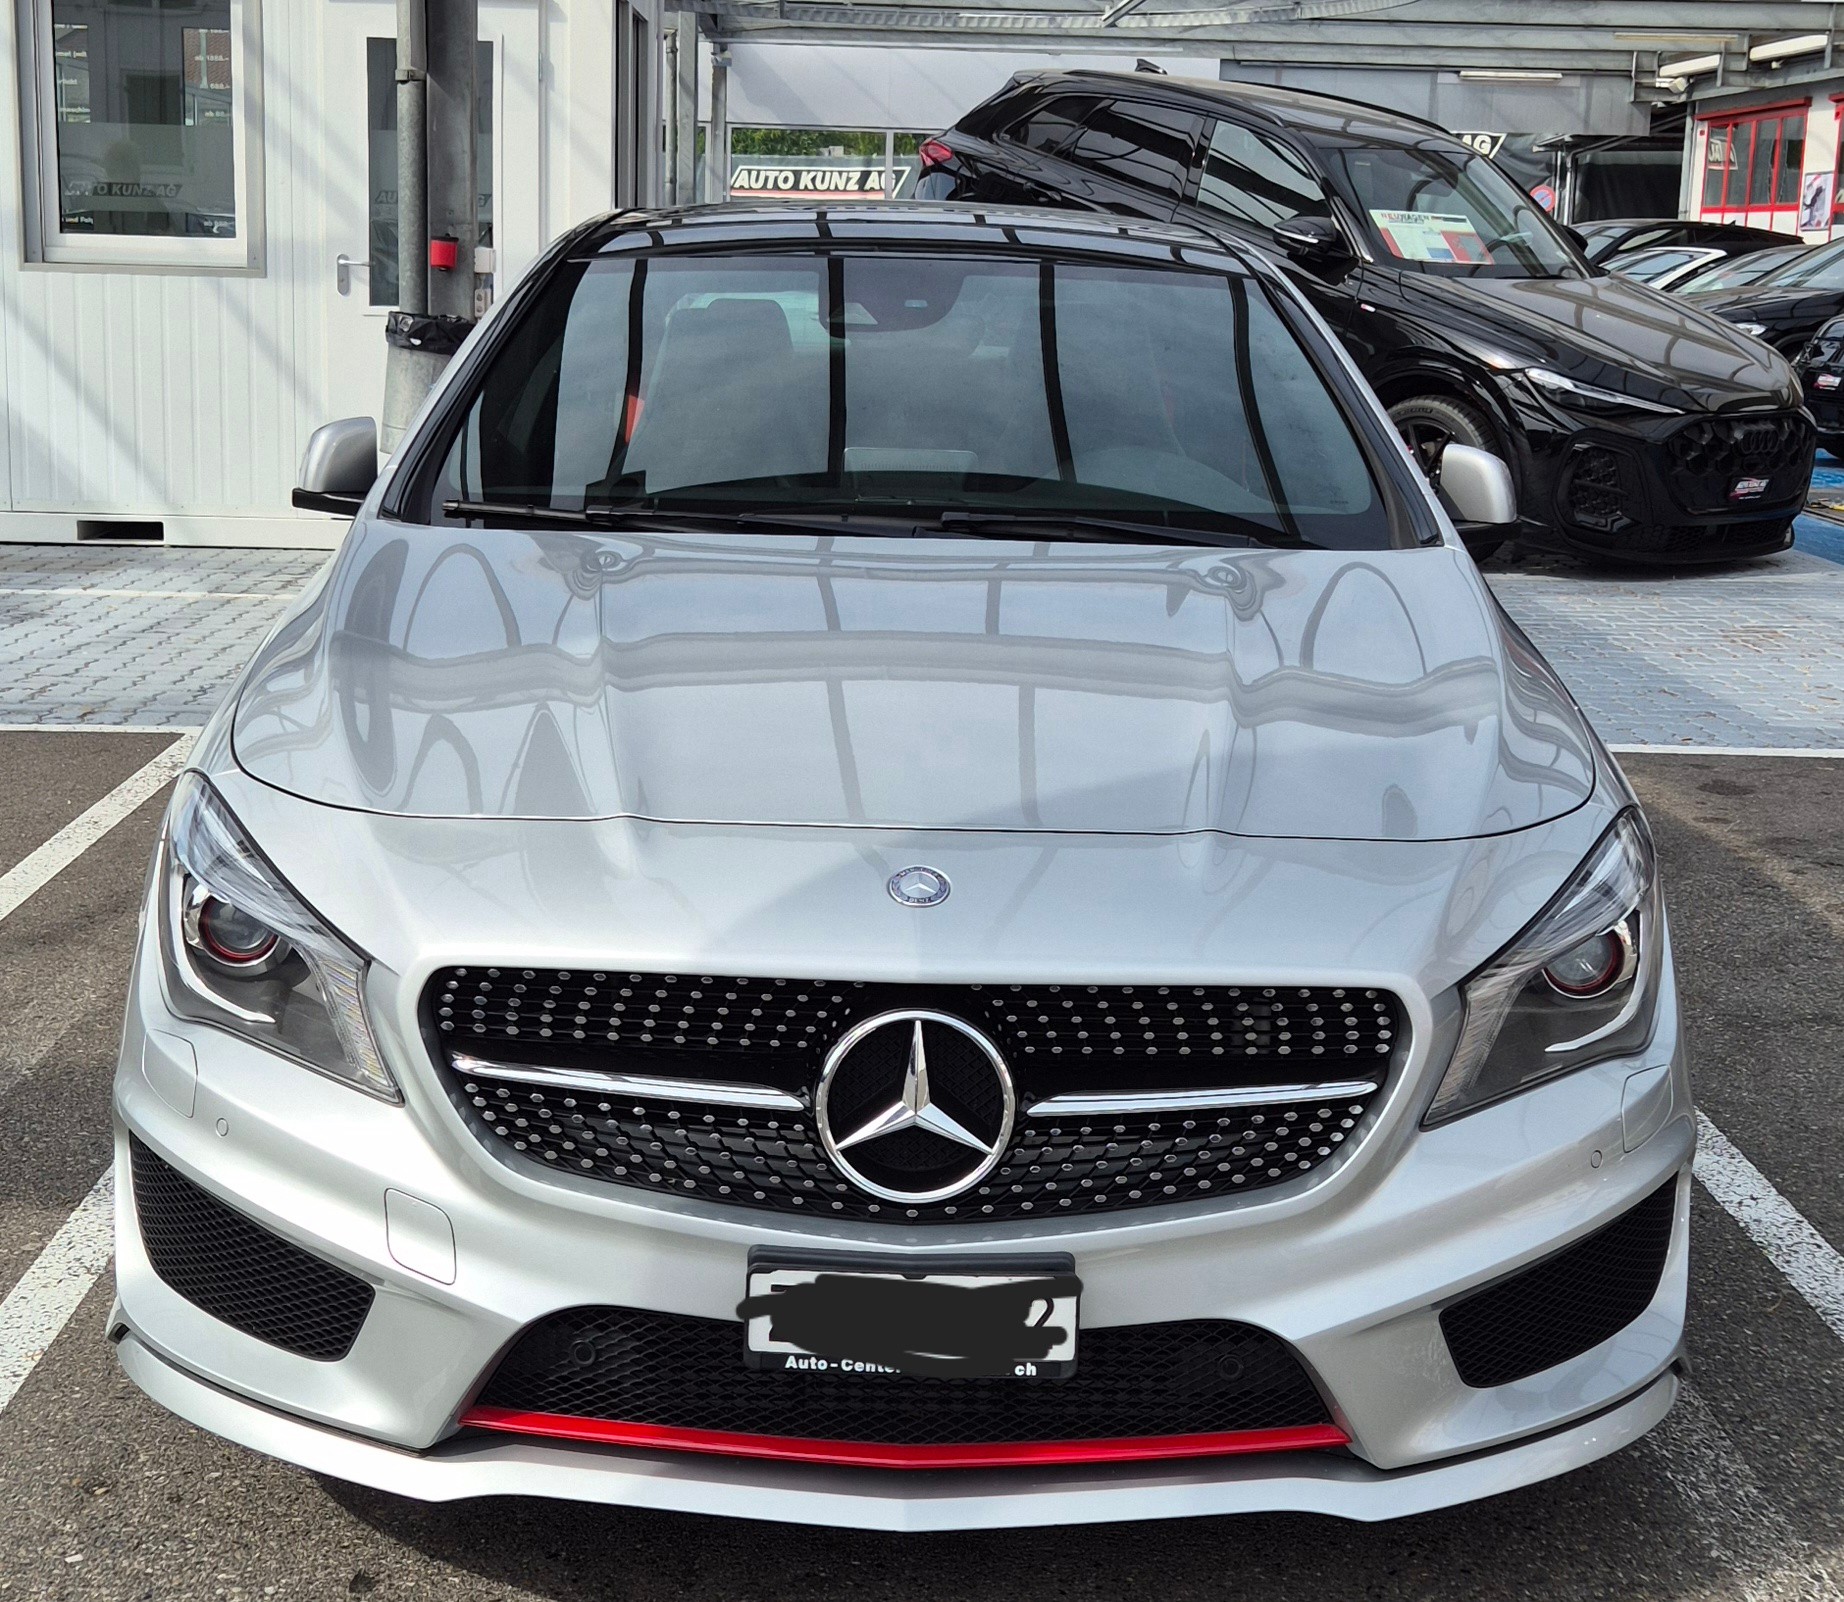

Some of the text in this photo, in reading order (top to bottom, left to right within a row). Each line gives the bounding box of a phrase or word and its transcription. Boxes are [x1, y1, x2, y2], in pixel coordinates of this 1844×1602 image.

[733, 169, 795, 190] AUTO
[799, 171, 861, 191] KUNZ
[111, 183, 154, 196] KUNZ
[155, 184, 177, 197] AG
